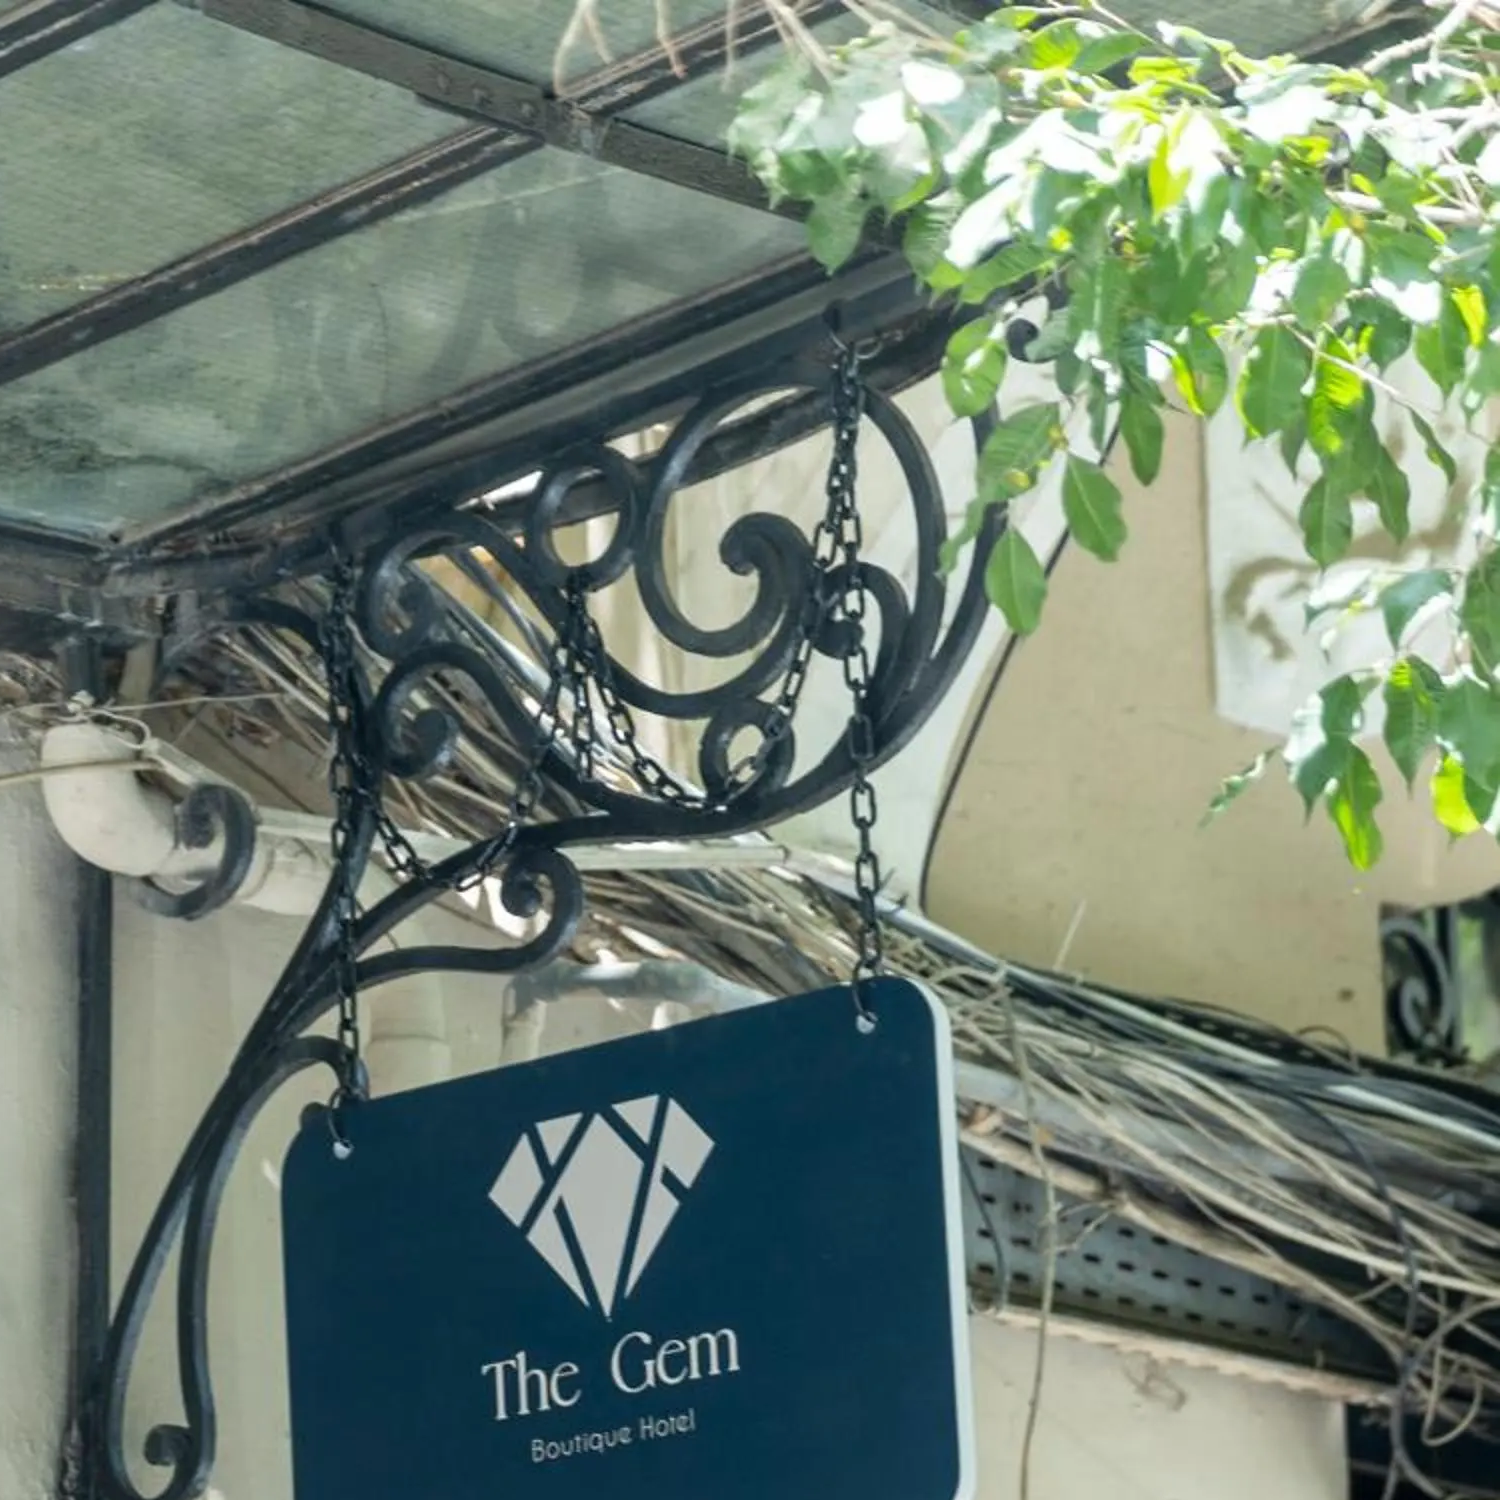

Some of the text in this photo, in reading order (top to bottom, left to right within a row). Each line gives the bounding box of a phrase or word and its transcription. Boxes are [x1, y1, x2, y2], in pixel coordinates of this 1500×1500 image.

[481, 1328, 740, 1420] The Gem
[531, 1408, 696, 1463] Boutique Hotel
